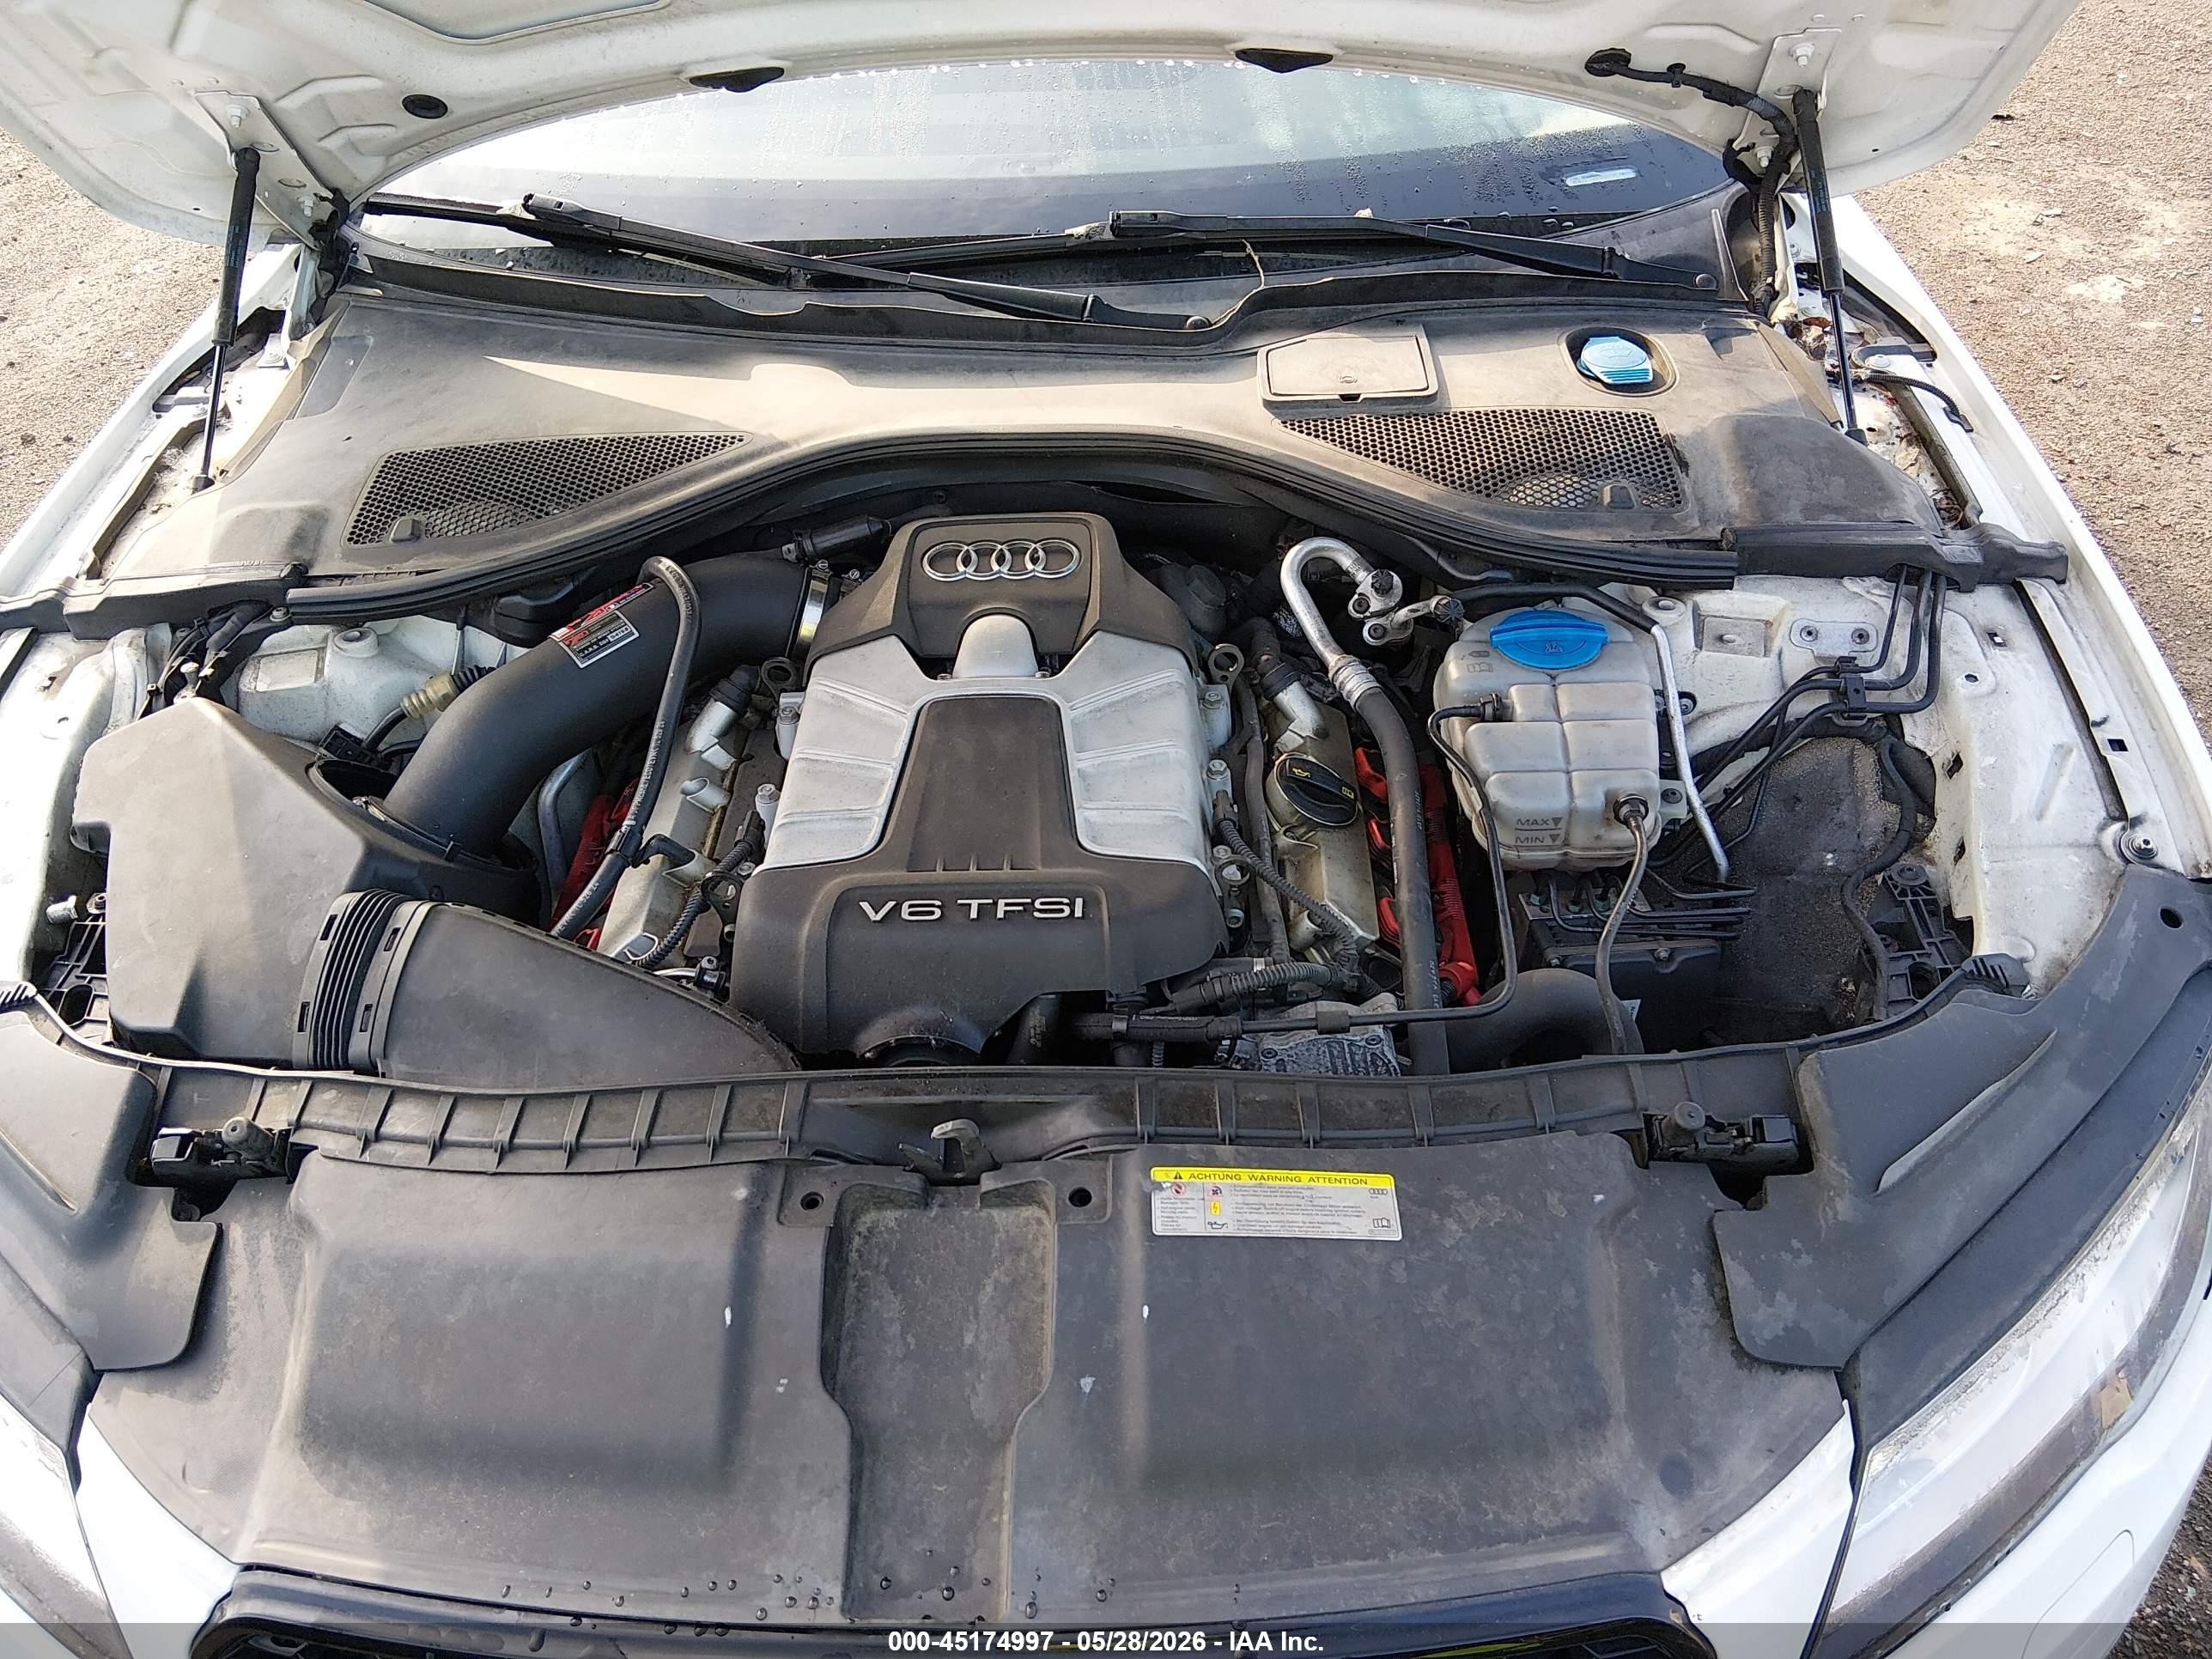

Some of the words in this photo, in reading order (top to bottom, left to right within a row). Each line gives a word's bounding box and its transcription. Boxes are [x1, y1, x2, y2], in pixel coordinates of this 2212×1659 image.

[859, 899, 943, 921] V6
[957, 897, 1085, 920] TFSI
[1188, 1172, 1242, 1182] ACHTUNG
[1248, 1174, 1302, 1183] WARNING
[1307, 1176, 1368, 1185] ATTENTION
